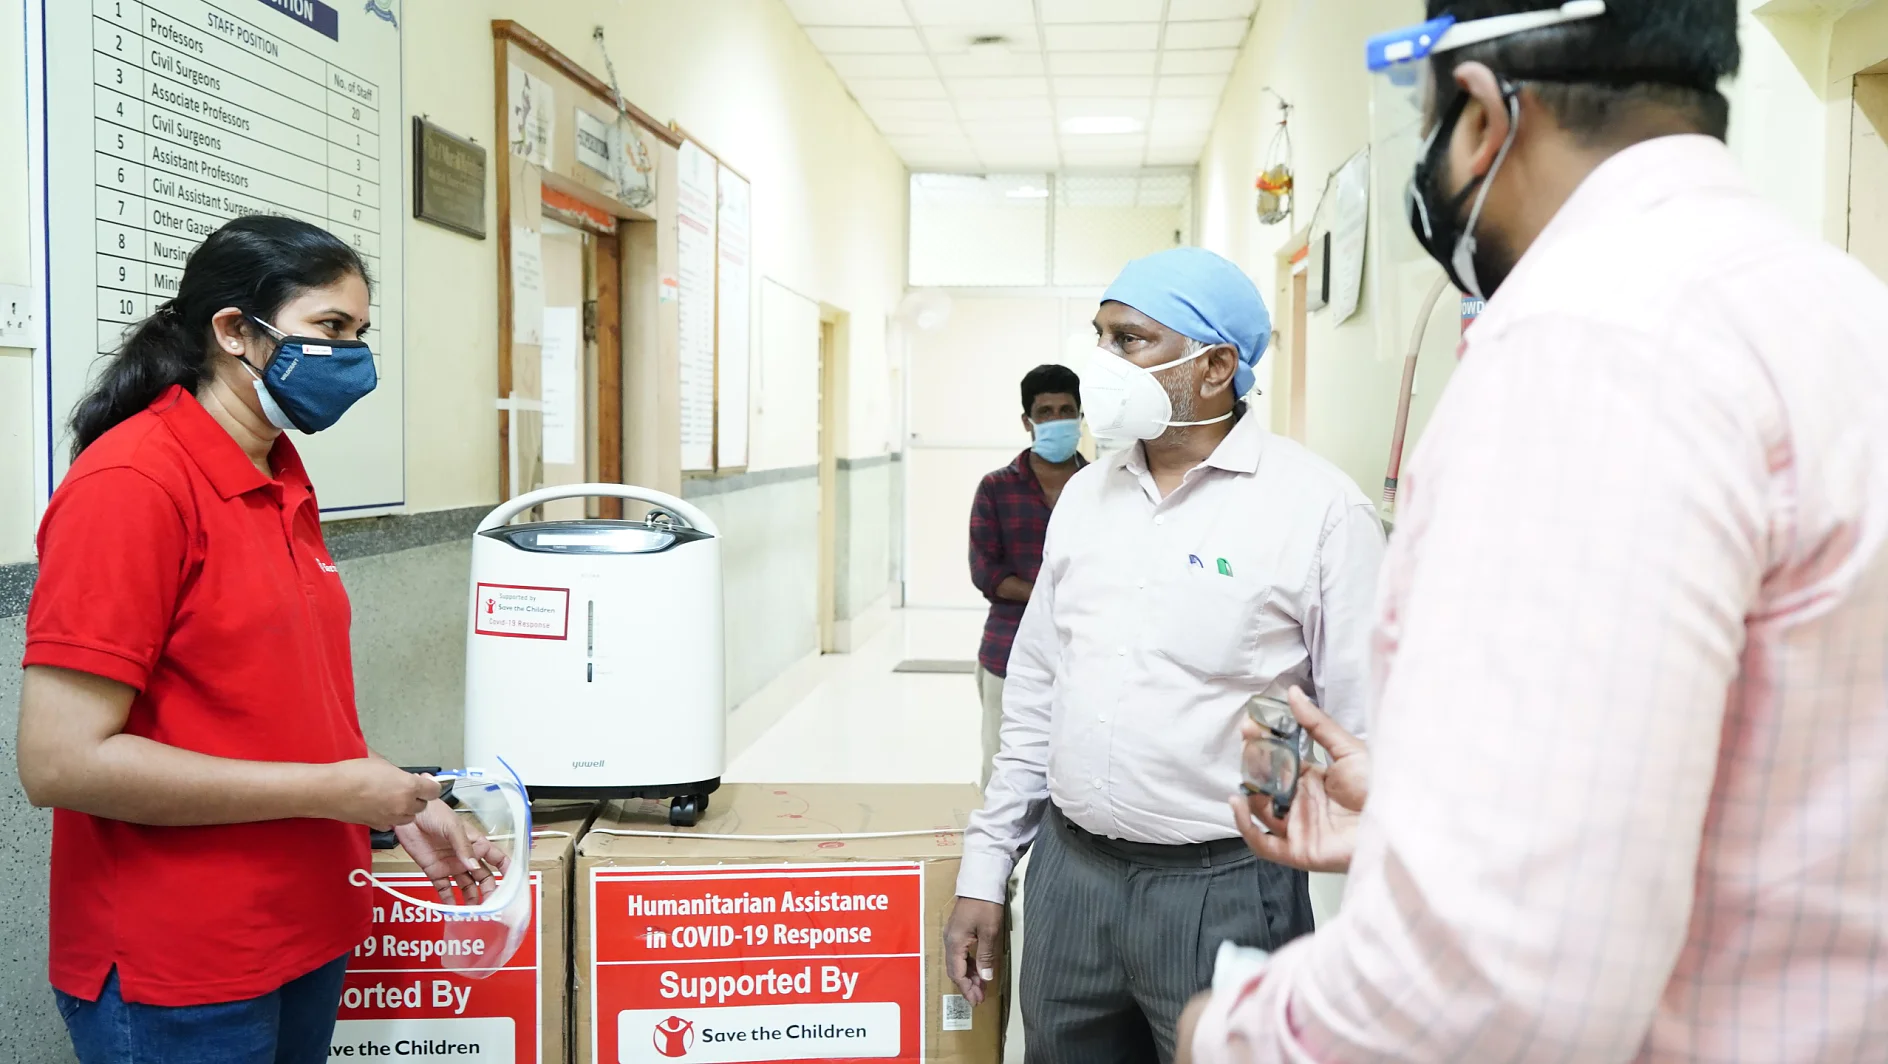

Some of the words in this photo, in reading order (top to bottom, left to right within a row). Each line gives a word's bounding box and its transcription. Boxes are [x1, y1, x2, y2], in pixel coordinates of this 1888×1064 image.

[115, 1, 122, 18] 1
[150, 17, 204, 53] Professors
[207, 12, 235, 37] STAFF
[237, 26, 279, 57] POSITION
[116, 35, 122, 51] 2
[116, 68, 123, 84] 3
[151, 50, 173, 72] Civil
[176, 60, 220, 91] Surgeons
[334, 73, 345, 89] No.
[347, 78, 356, 93] of
[357, 83, 373, 101] Staff
[116, 101, 124, 117] 4
[151, 82, 200, 113] Associate
[203, 101, 250, 131] Professors
[351, 106, 360, 121] 20
[152, 114, 174, 134] Civil
[176, 122, 222, 150] Surgeons
[356, 134, 361, 146] 1
[117, 134, 124, 150] 5
[152, 146, 198, 174] Assistant
[201, 161, 249, 188] Professors
[356, 159, 361, 171] 3
[117, 167, 125, 183] 6
[152, 178, 175, 197] Civil
[178, 185, 222, 210] Assistant
[356, 184, 362, 197] 2
[118, 200, 125, 215] 7
[352, 208, 361, 221] 47
[153, 209, 184, 230] Other
[118, 233, 126, 249] 8
[353, 233, 361, 247] 15
[118, 266, 126, 282] 9
[119, 299, 134, 315] 10
[499, 592, 528, 601] Supported
[526, 605, 556, 613] Children
[489, 618, 516, 626] Covid-19
[517, 620, 551, 629] Response
[572, 759, 605, 769] yuwell
[627, 892, 776, 917] Humanitarian
[780, 890, 889, 913] Assistance
[646, 927, 667, 949] in
[671, 924, 769, 948] COVID-19
[773, 923, 872, 949] Response
[382, 934, 485, 962] Response
[660, 966, 811, 1004] Supported
[821, 965, 859, 999] By
[338, 980, 422, 1009] orted
[432, 980, 472, 1015] By
[701, 1027, 747, 1043] Save
[751, 1026, 782, 1041] the
[785, 1024, 867, 1040] Children
[358, 1041, 391, 1056] the
[395, 1039, 480, 1056] Children
